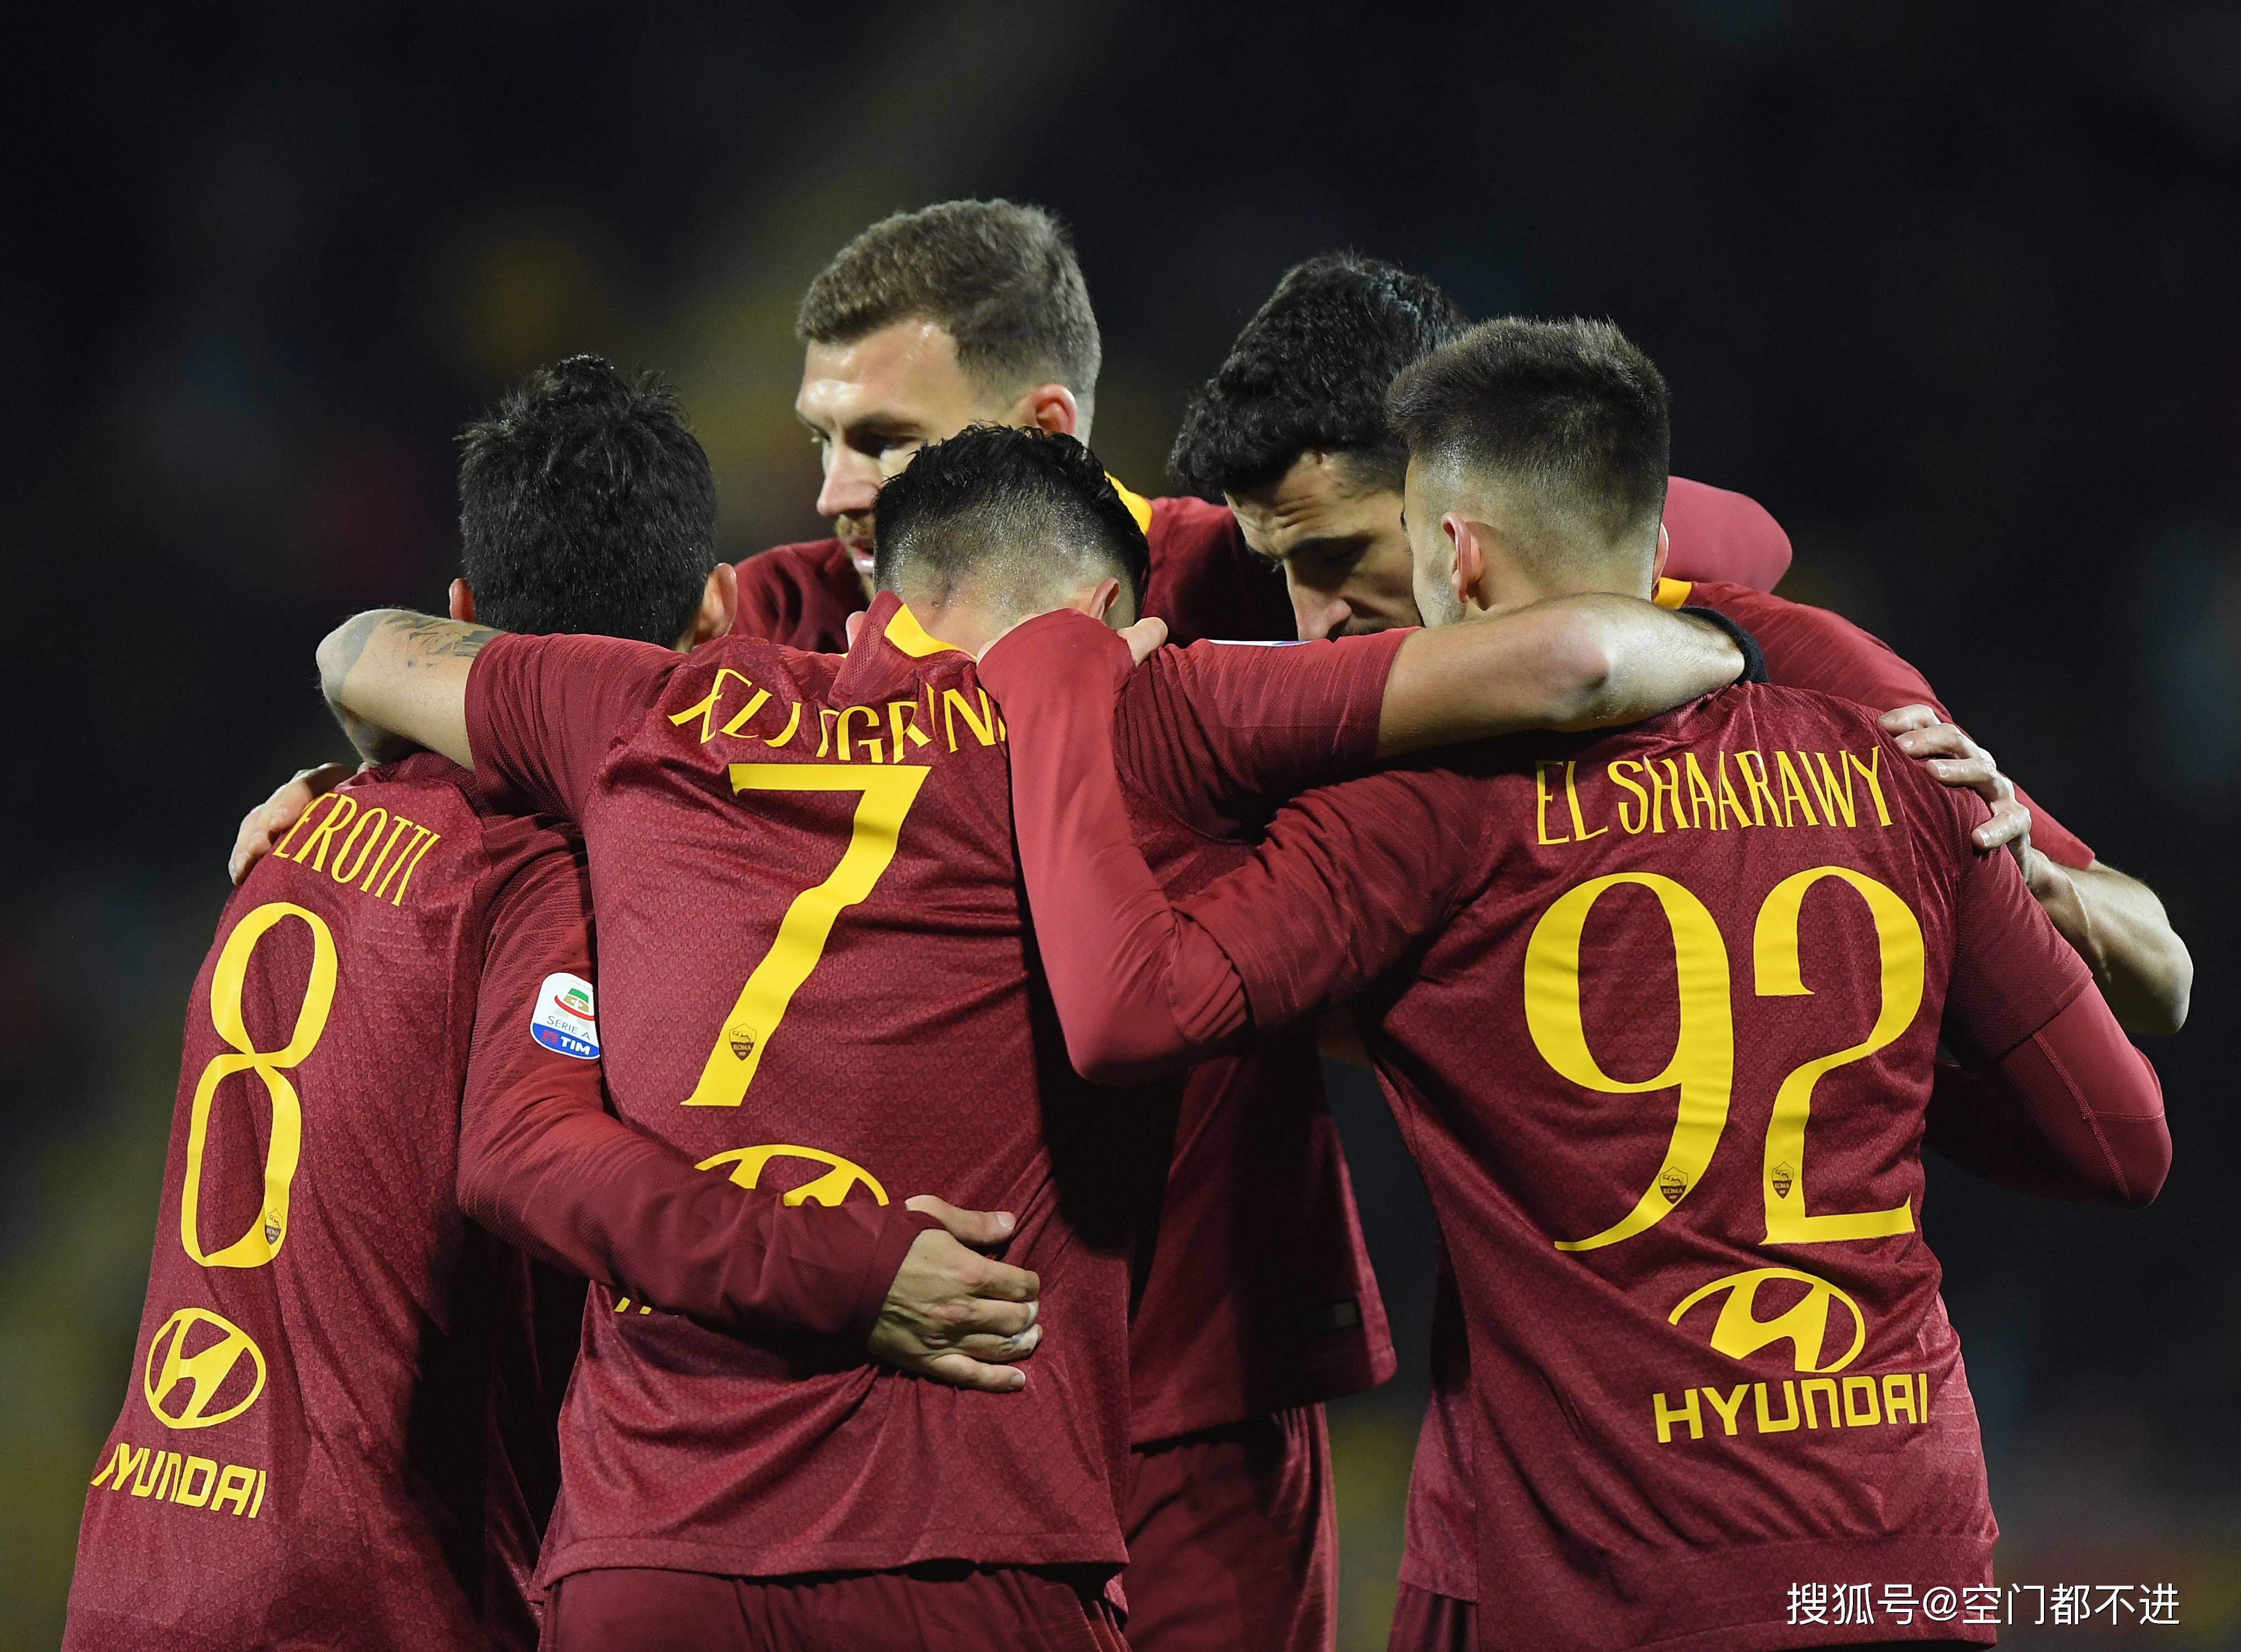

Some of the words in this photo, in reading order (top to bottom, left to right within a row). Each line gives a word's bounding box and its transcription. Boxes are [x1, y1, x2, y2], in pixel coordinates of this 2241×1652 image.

[1535, 760, 1609, 845] EL
[1607, 746, 1894, 834] SHAARAWY
[277, 792, 441, 906] EROTTI
[683, 763, 931, 1107] 7
[546, 1015, 578, 1035] SERIE
[581, 1031, 591, 1041] A
[560, 1036, 591, 1055] TIM
[1524, 865, 1925, 1251] 92
[180, 902, 338, 1268] 8
[1653, 1373, 1928, 1443] HYUNDAI
